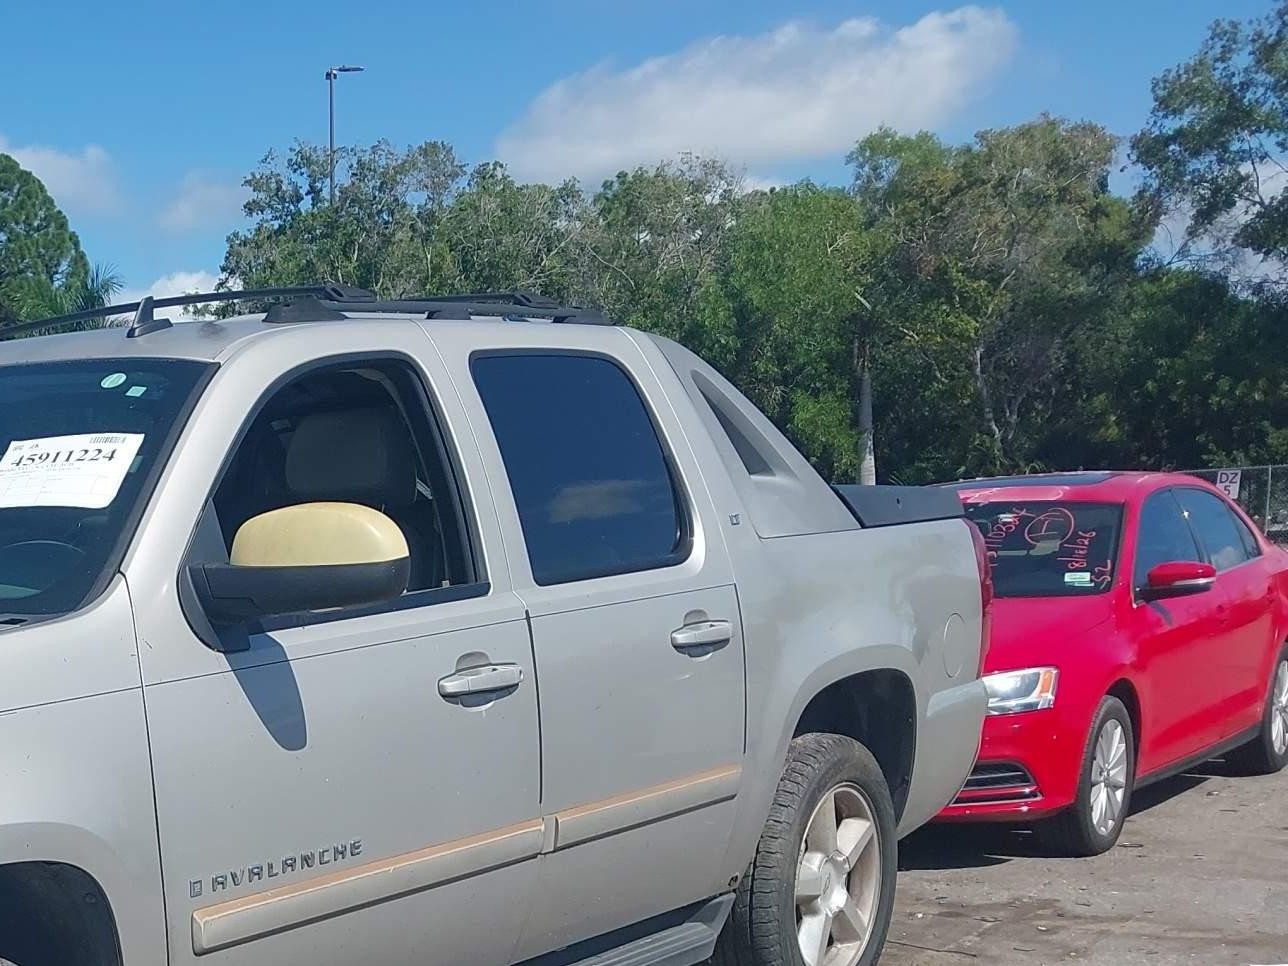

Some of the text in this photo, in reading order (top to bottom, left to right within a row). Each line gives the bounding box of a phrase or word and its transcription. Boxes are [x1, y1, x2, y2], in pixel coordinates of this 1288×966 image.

[10, 447, 118, 468] 45911224
[1219, 471, 1239, 485] DZ
[1223, 484, 1232, 496] 5
[211, 839, 363, 892] AVALANCHE
